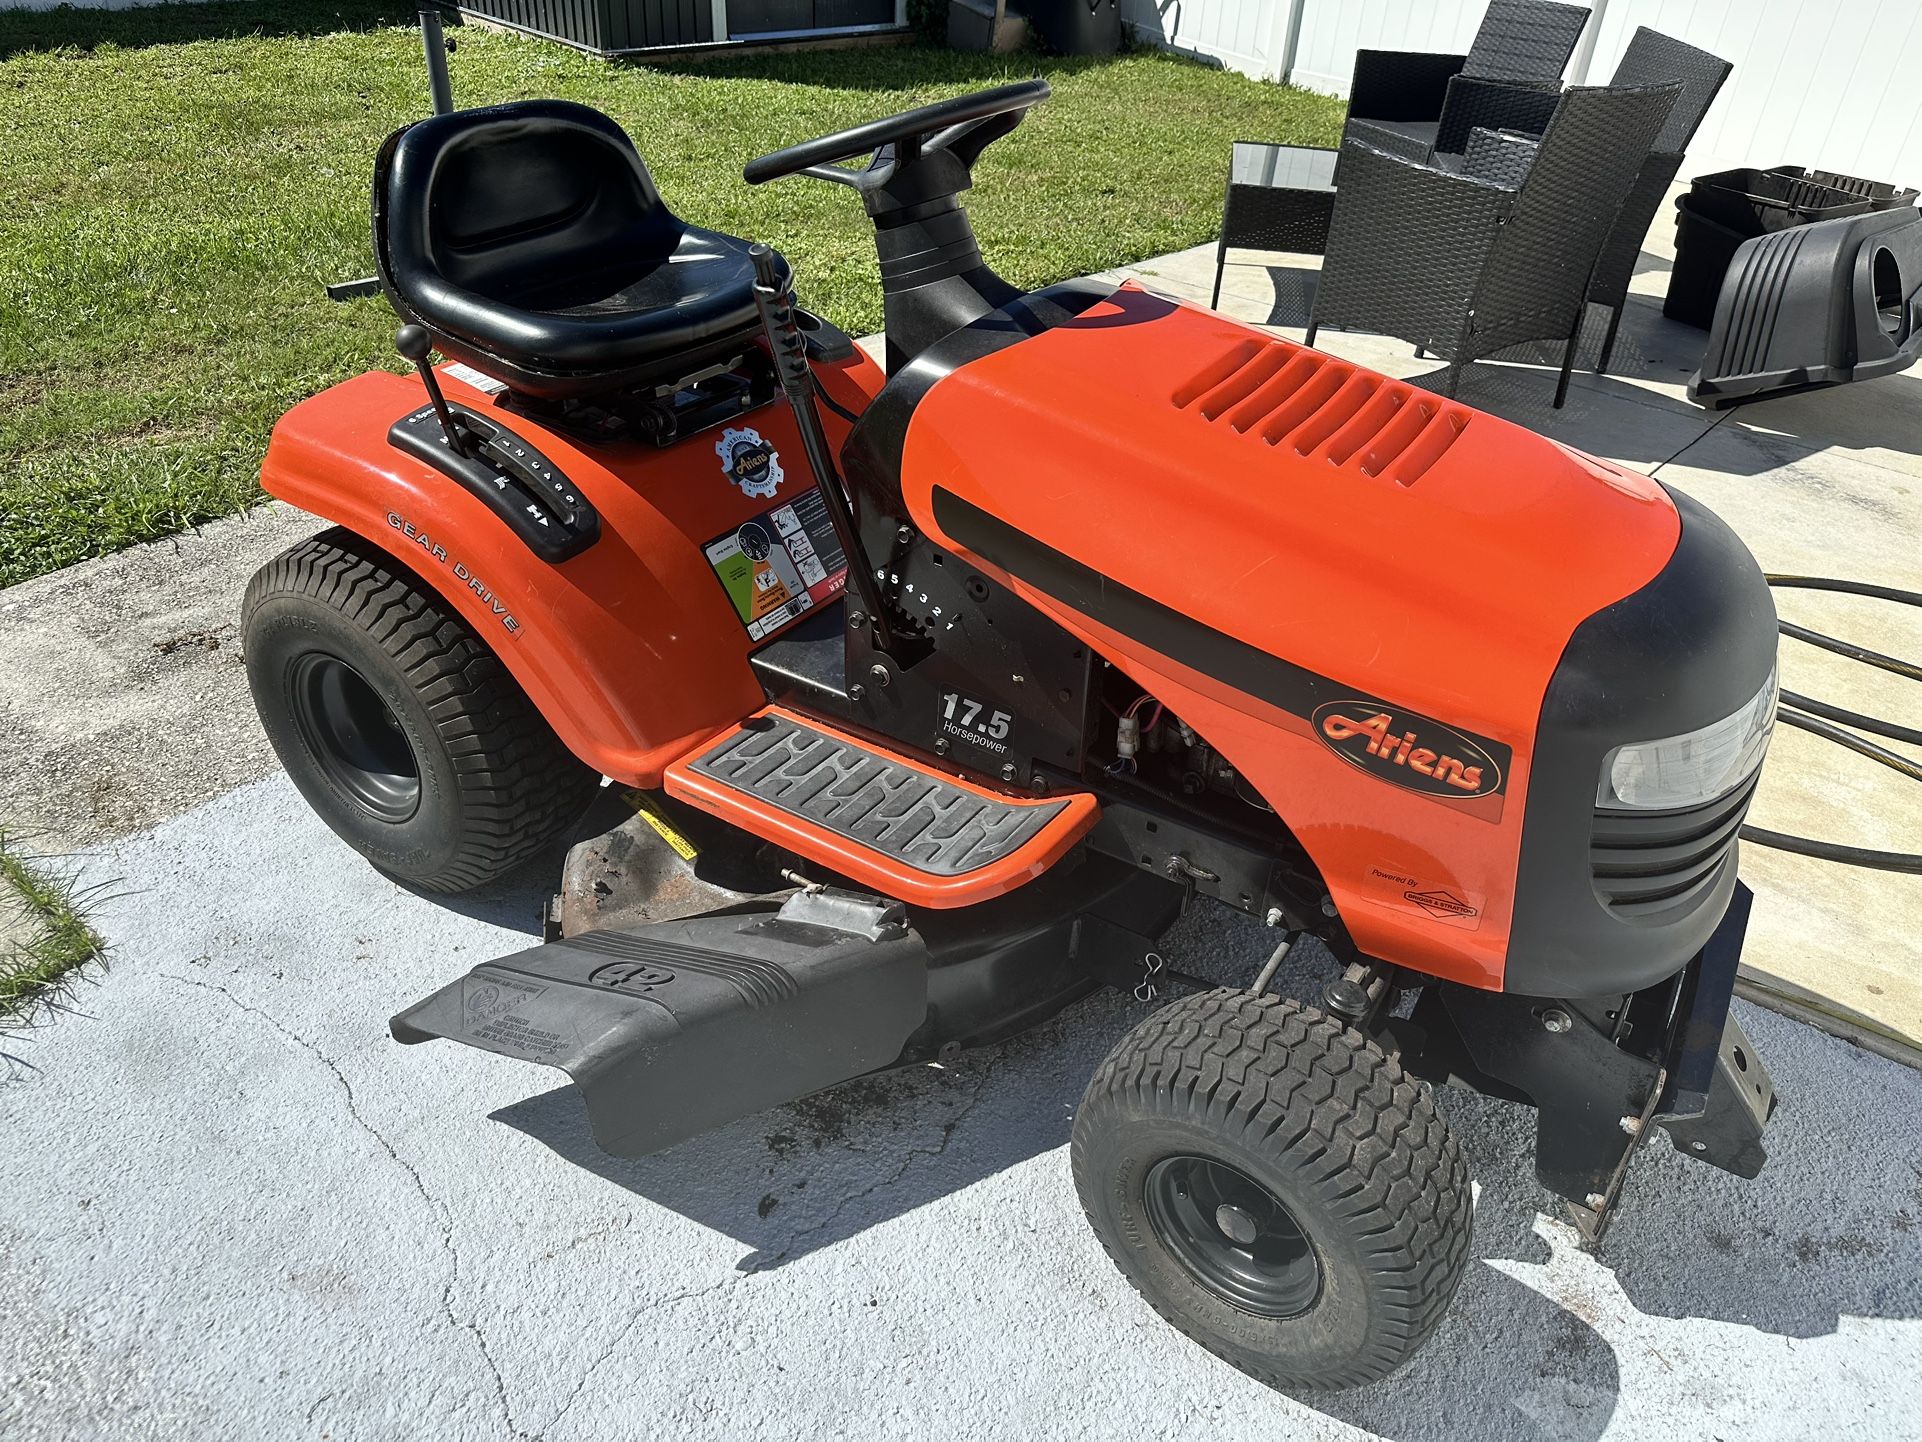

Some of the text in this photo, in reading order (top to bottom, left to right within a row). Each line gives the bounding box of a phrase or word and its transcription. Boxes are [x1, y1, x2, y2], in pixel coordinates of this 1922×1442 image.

[726, 435, 752, 452] AMERICAN
[515, 448, 525, 457] 2
[531, 461, 541, 469] 3
[543, 472, 551, 480] 4
[554, 483, 563, 491] 5
[565, 495, 575, 503] 6
[736, 453, 768, 475] Ariens
[386, 511, 520, 633] GEAR DRIVE
[877, 570, 954, 631] 6 5 4 3 2 1
[943, 693, 1011, 740] 17.5
[943, 719, 1008, 754] Horsepower
[1322, 713, 1483, 791] Ariens
[1371, 868, 1418, 888] Powered By
[1408, 893, 1433, 904] BRIGGS
[1440, 902, 1474, 915] STRATTON
[595, 964, 660, 992] 42
